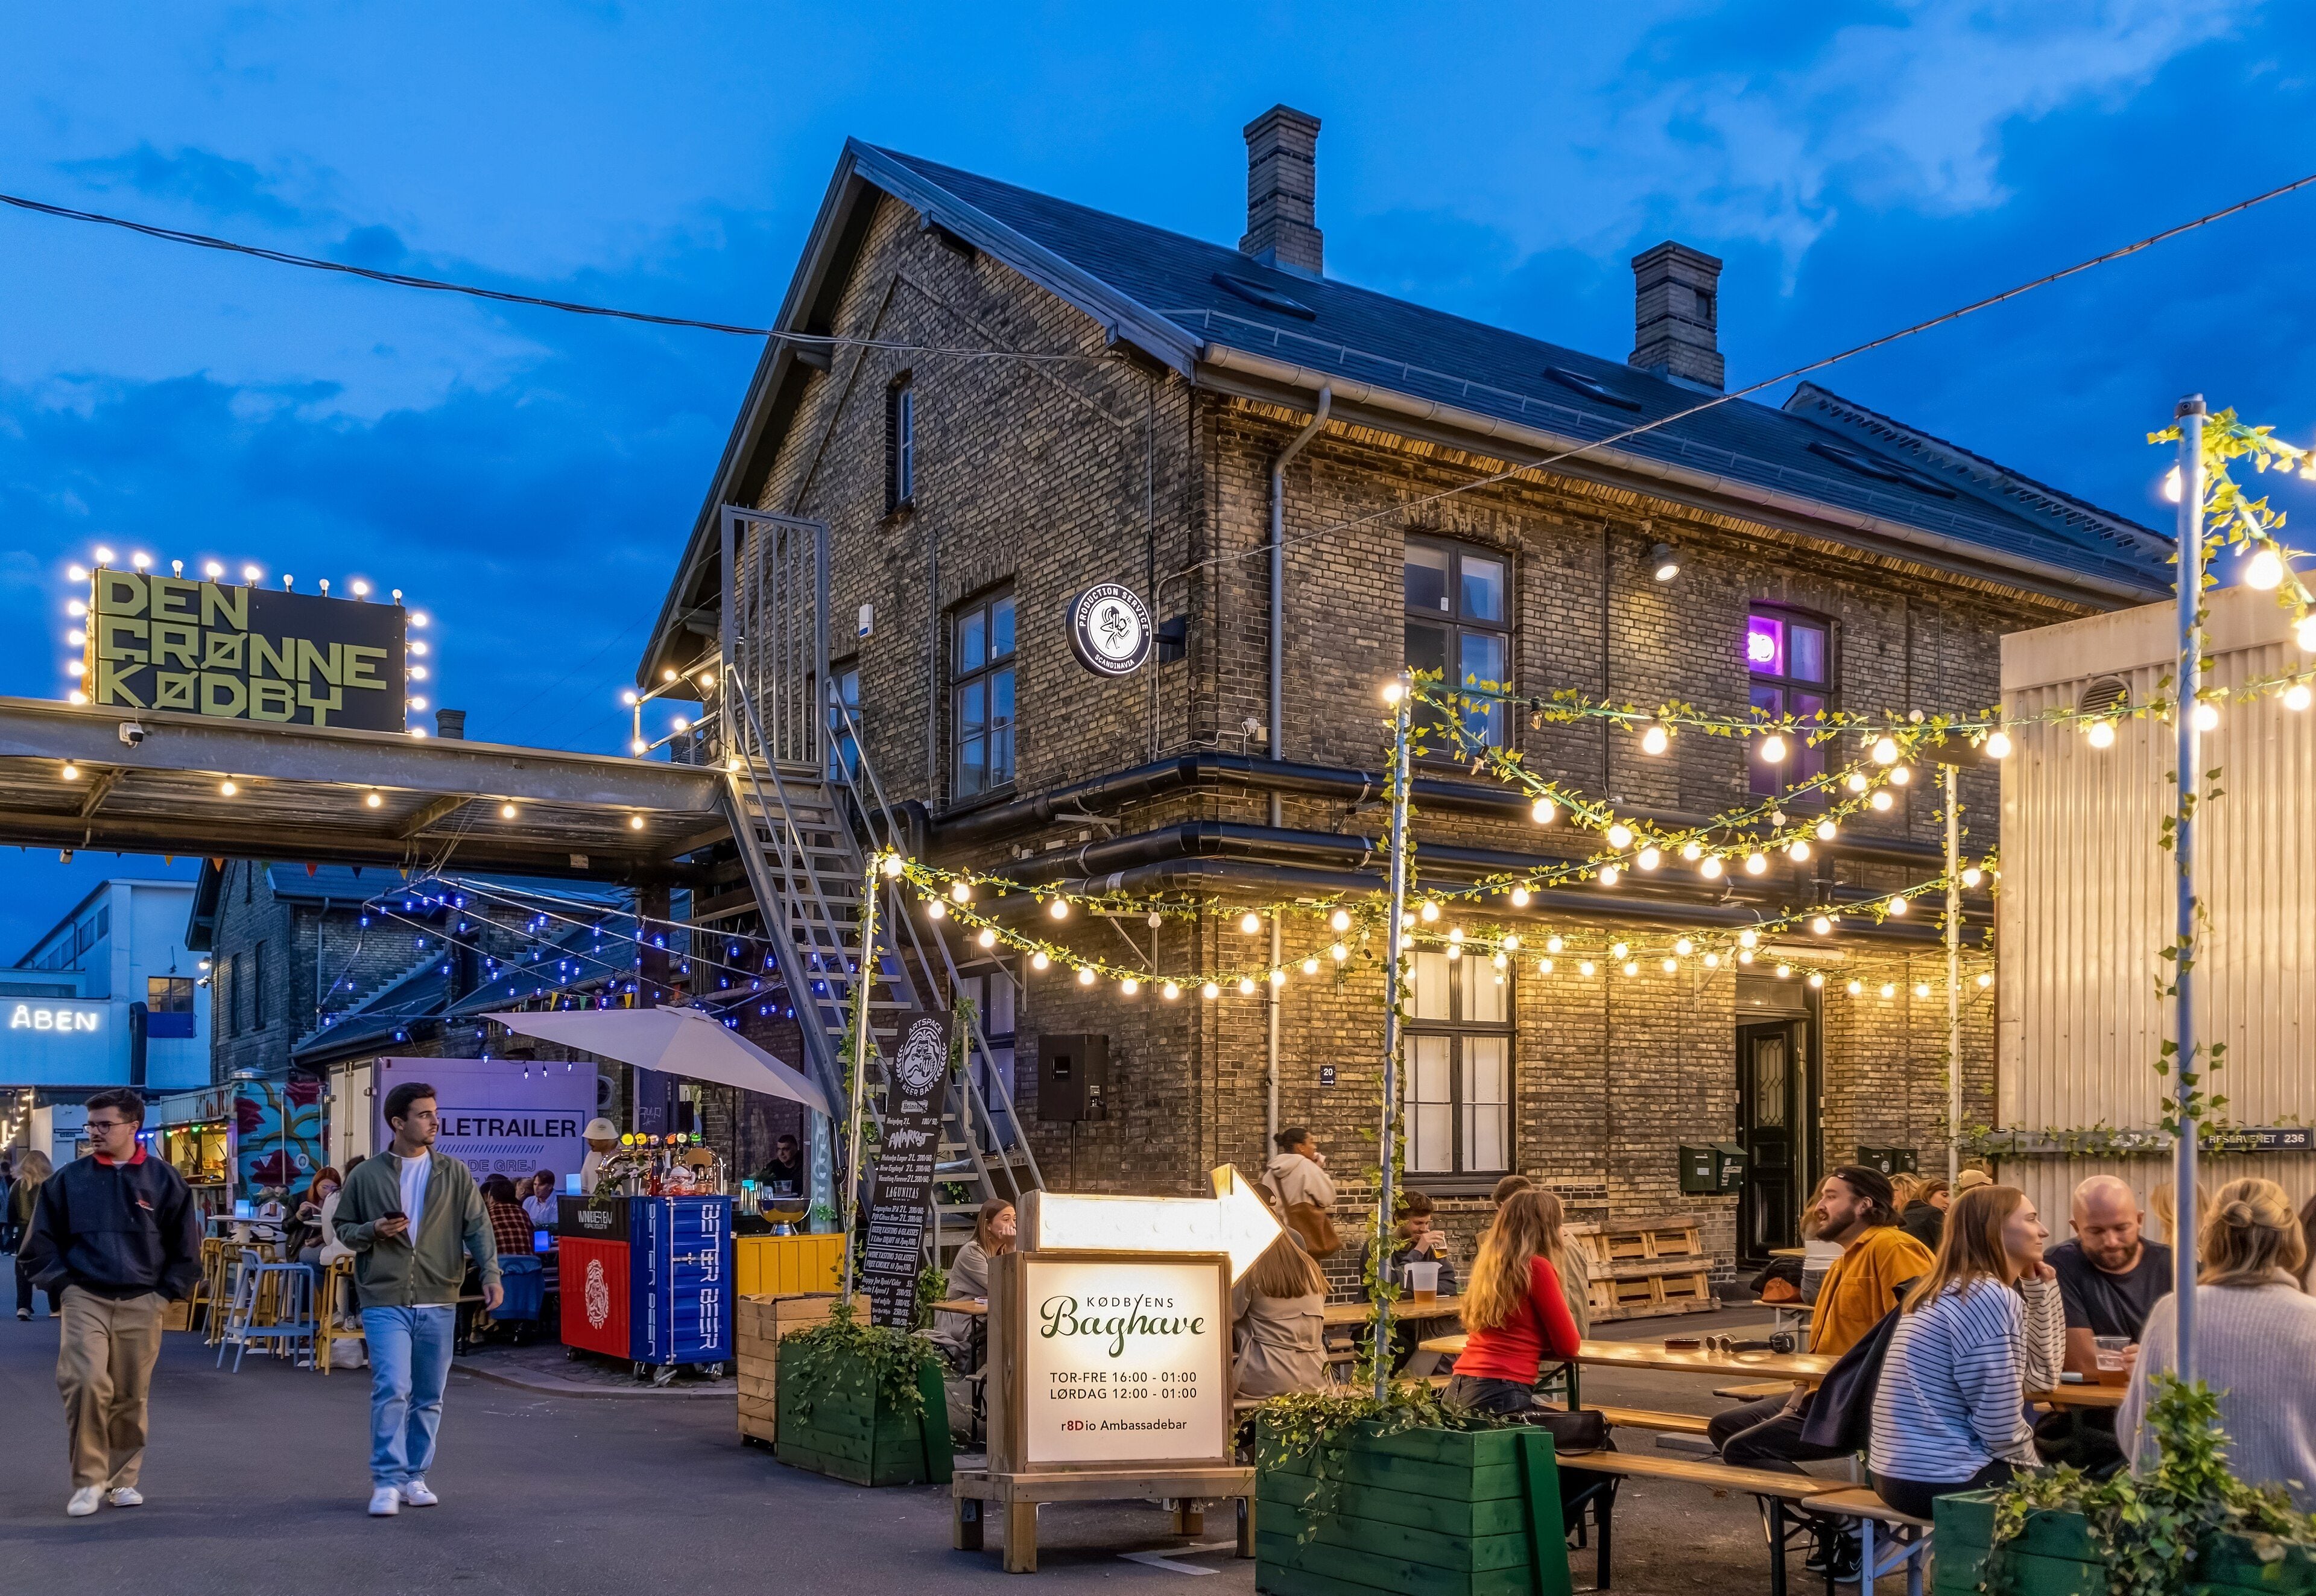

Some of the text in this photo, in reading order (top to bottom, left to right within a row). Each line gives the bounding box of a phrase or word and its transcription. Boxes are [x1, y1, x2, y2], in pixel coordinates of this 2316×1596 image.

[98, 569, 248, 631] DEN
[1079, 587, 1149, 629] PRODUCTION SERVICE
[98, 613, 387, 690] GRØNNE
[1095, 654, 1135, 669] SCANDINAVIA
[98, 659, 343, 726] KØDBY
[11, 1005, 97, 1030] ÅBEN
[908, 1018, 943, 1036] ARTSPACE
[1323, 1068, 1333, 1076] 20
[902, 1081, 934, 1097] BEER BAR
[441, 1118, 577, 1138] LETRAILER
[2283, 1134, 2305, 1144] 236
[493, 1159, 536, 1172] GREJ
[885, 1186, 919, 1199] LAGUNITAS
[699, 1204, 721, 1350] BETTER BEER
[1087, 1294, 1174, 1308] KØDBYENS
[1040, 1295, 1206, 1358] Baghave
[1050, 1372, 1107, 1383] TOR-FRE
[1112, 1372, 1148, 1382] 16:00
[1162, 1372, 1197, 1382] 01:00
[1050, 1389, 1107, 1399] LØRDAG
[1112, 1388, 1148, 1399] 12:00
[1162, 1388, 1197, 1399] 01:00
[1061, 1419, 1187, 1431] r8Dio Ambassadebar
